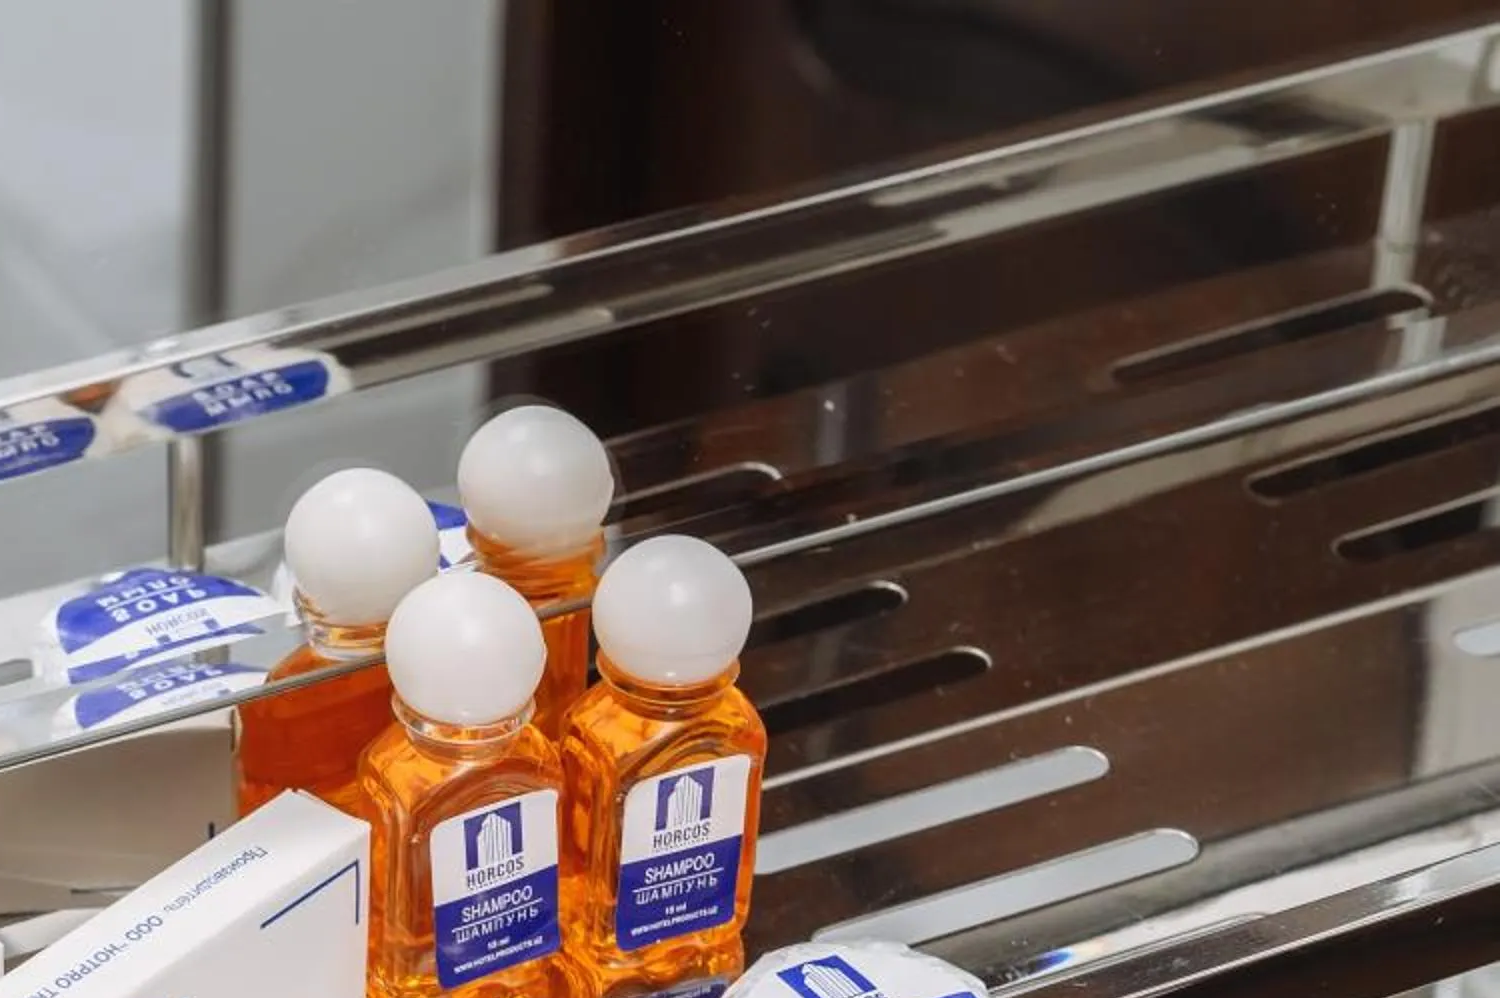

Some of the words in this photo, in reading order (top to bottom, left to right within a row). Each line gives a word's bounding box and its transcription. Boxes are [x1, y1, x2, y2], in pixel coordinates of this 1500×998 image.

[653, 821, 711, 849] HORCOS
[466, 855, 525, 888] HORCOS
[644, 852, 715, 884] SHAMPOO
[461, 885, 533, 923] SHAMPOO
[635, 874, 718, 905] ШАМПУНЬ
[455, 904, 540, 944] ШАМПУНЬ
